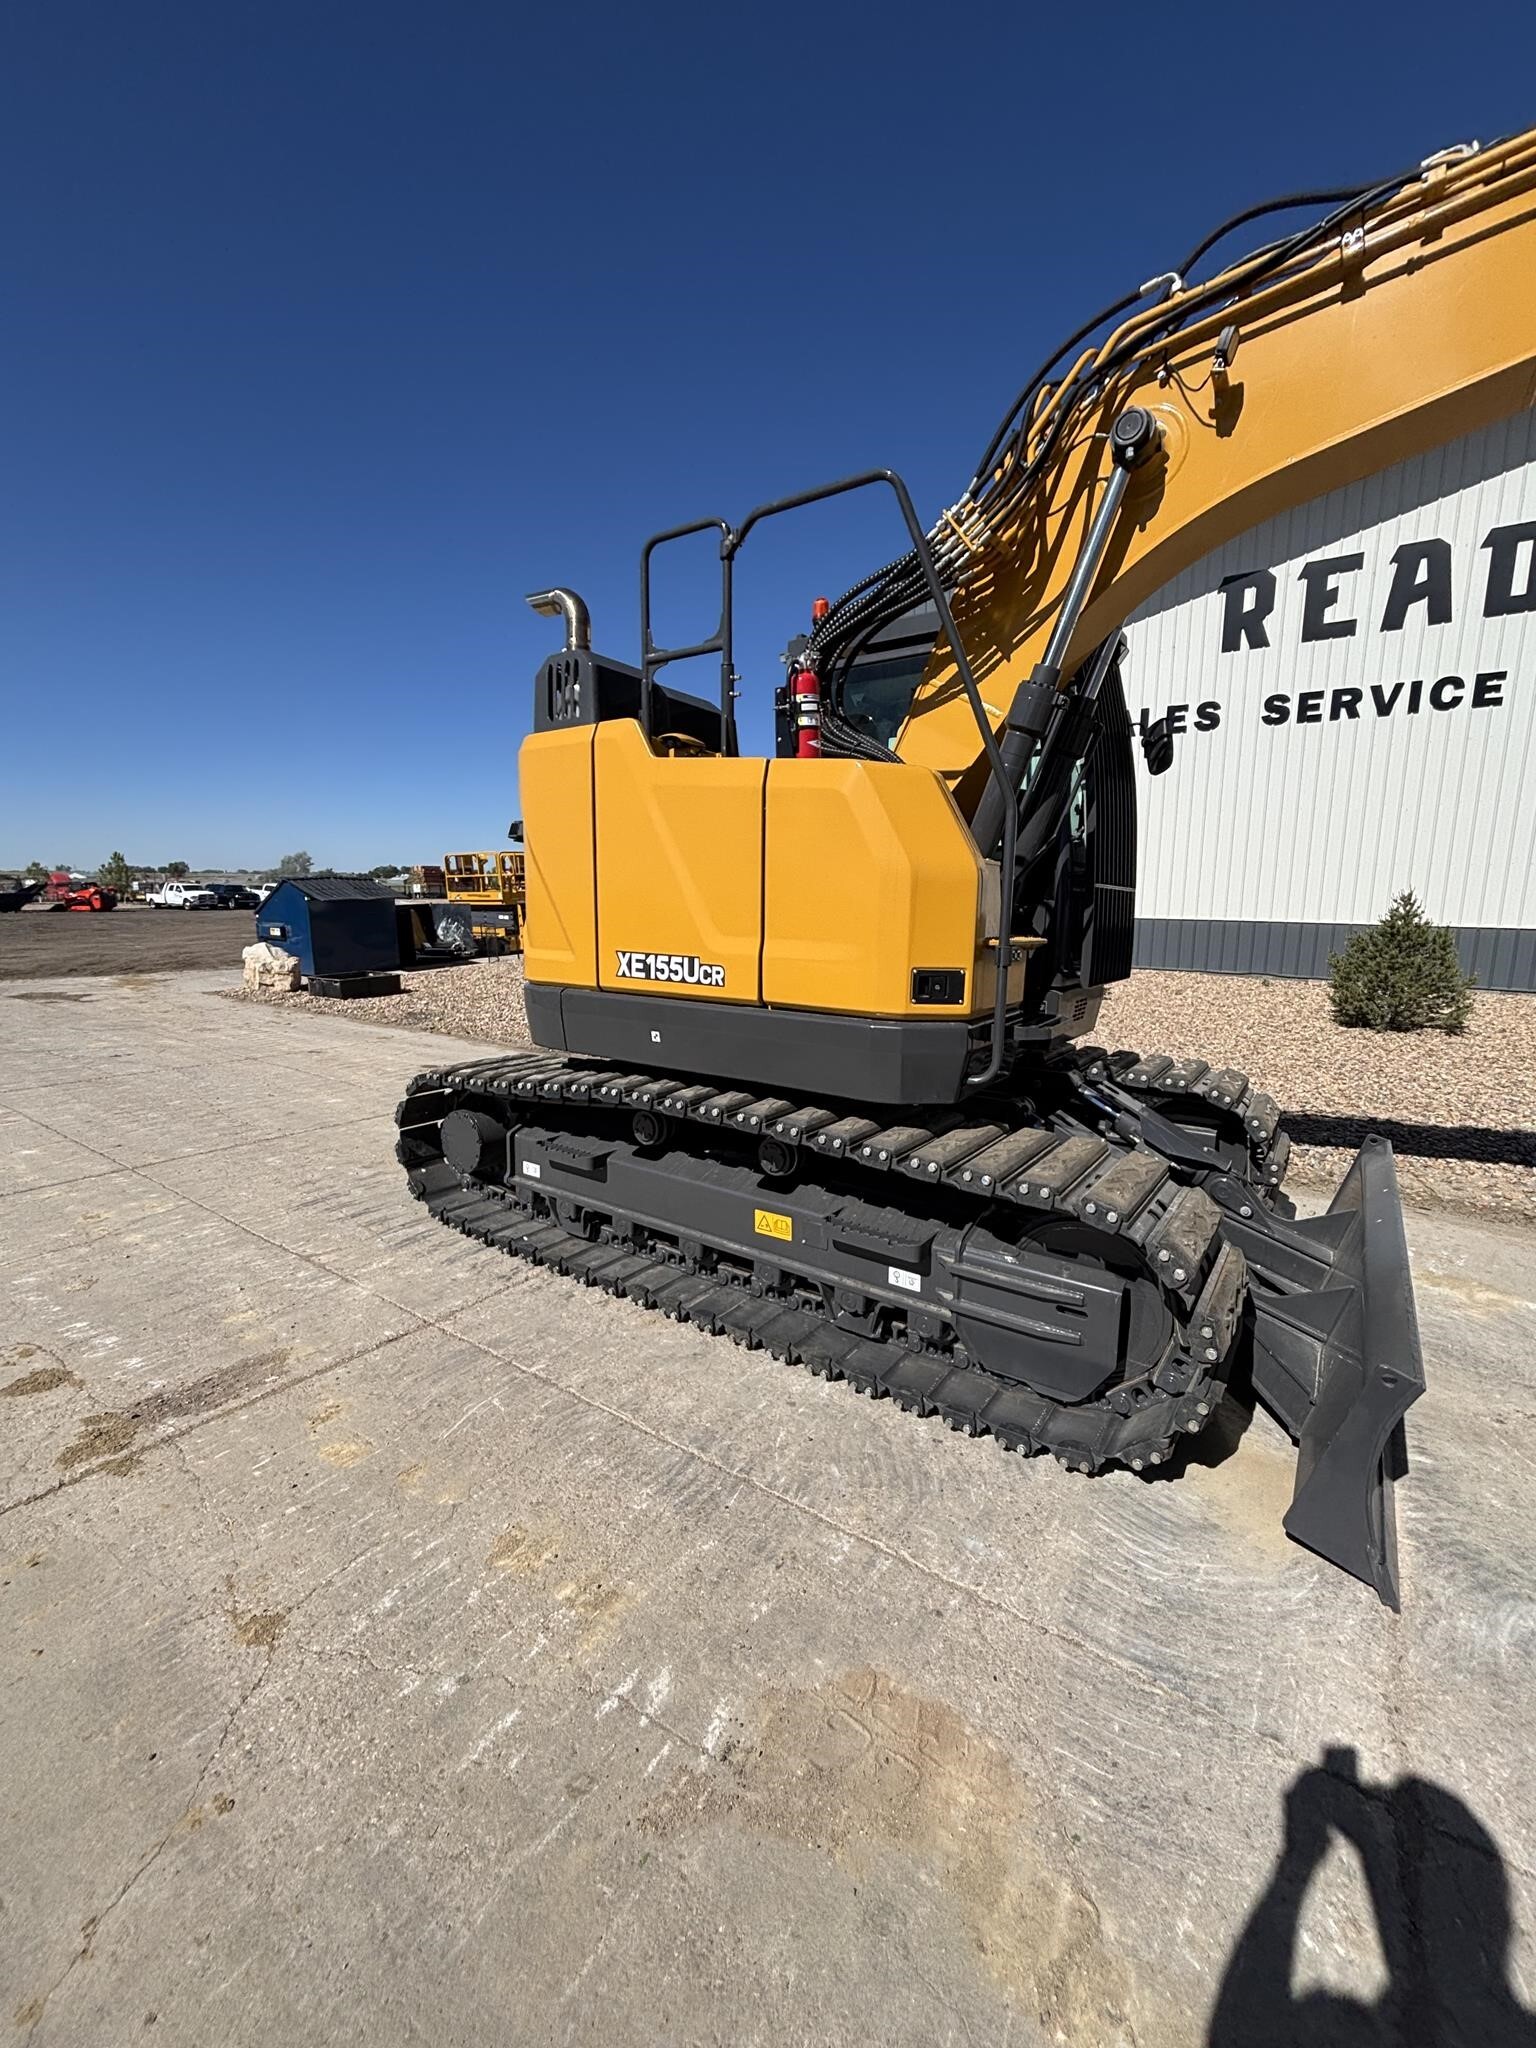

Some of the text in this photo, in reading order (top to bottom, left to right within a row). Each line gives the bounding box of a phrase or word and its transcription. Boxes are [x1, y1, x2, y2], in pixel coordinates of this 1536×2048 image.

[1217, 520, 1536, 653] READ
[1127, 671, 1508, 737] LES SERVICE
